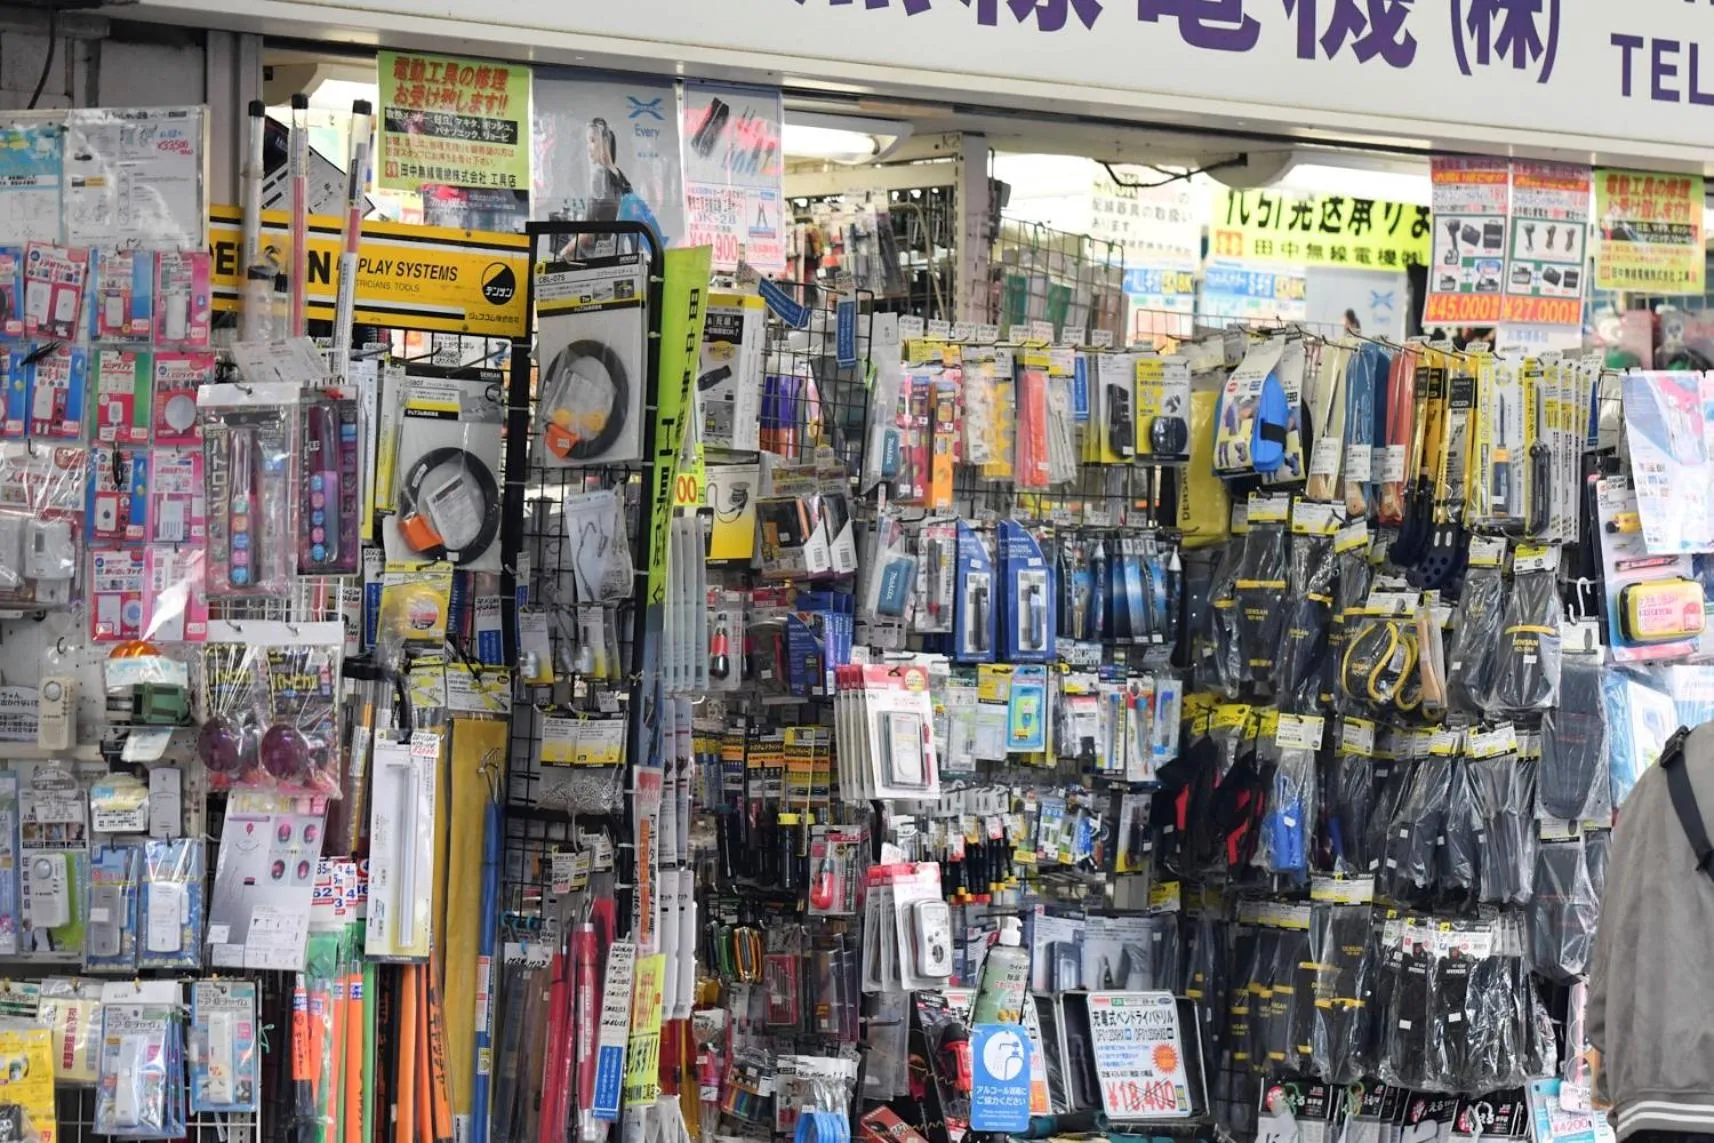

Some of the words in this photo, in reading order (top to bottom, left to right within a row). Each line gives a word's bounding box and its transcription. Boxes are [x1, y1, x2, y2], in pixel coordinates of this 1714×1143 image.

[393, 56, 510, 91] 電動工具の修理
[1610, 33, 1714, 106] TEL
[634, 124, 660, 140] Every
[396, 261, 458, 283] SYSTEMS
